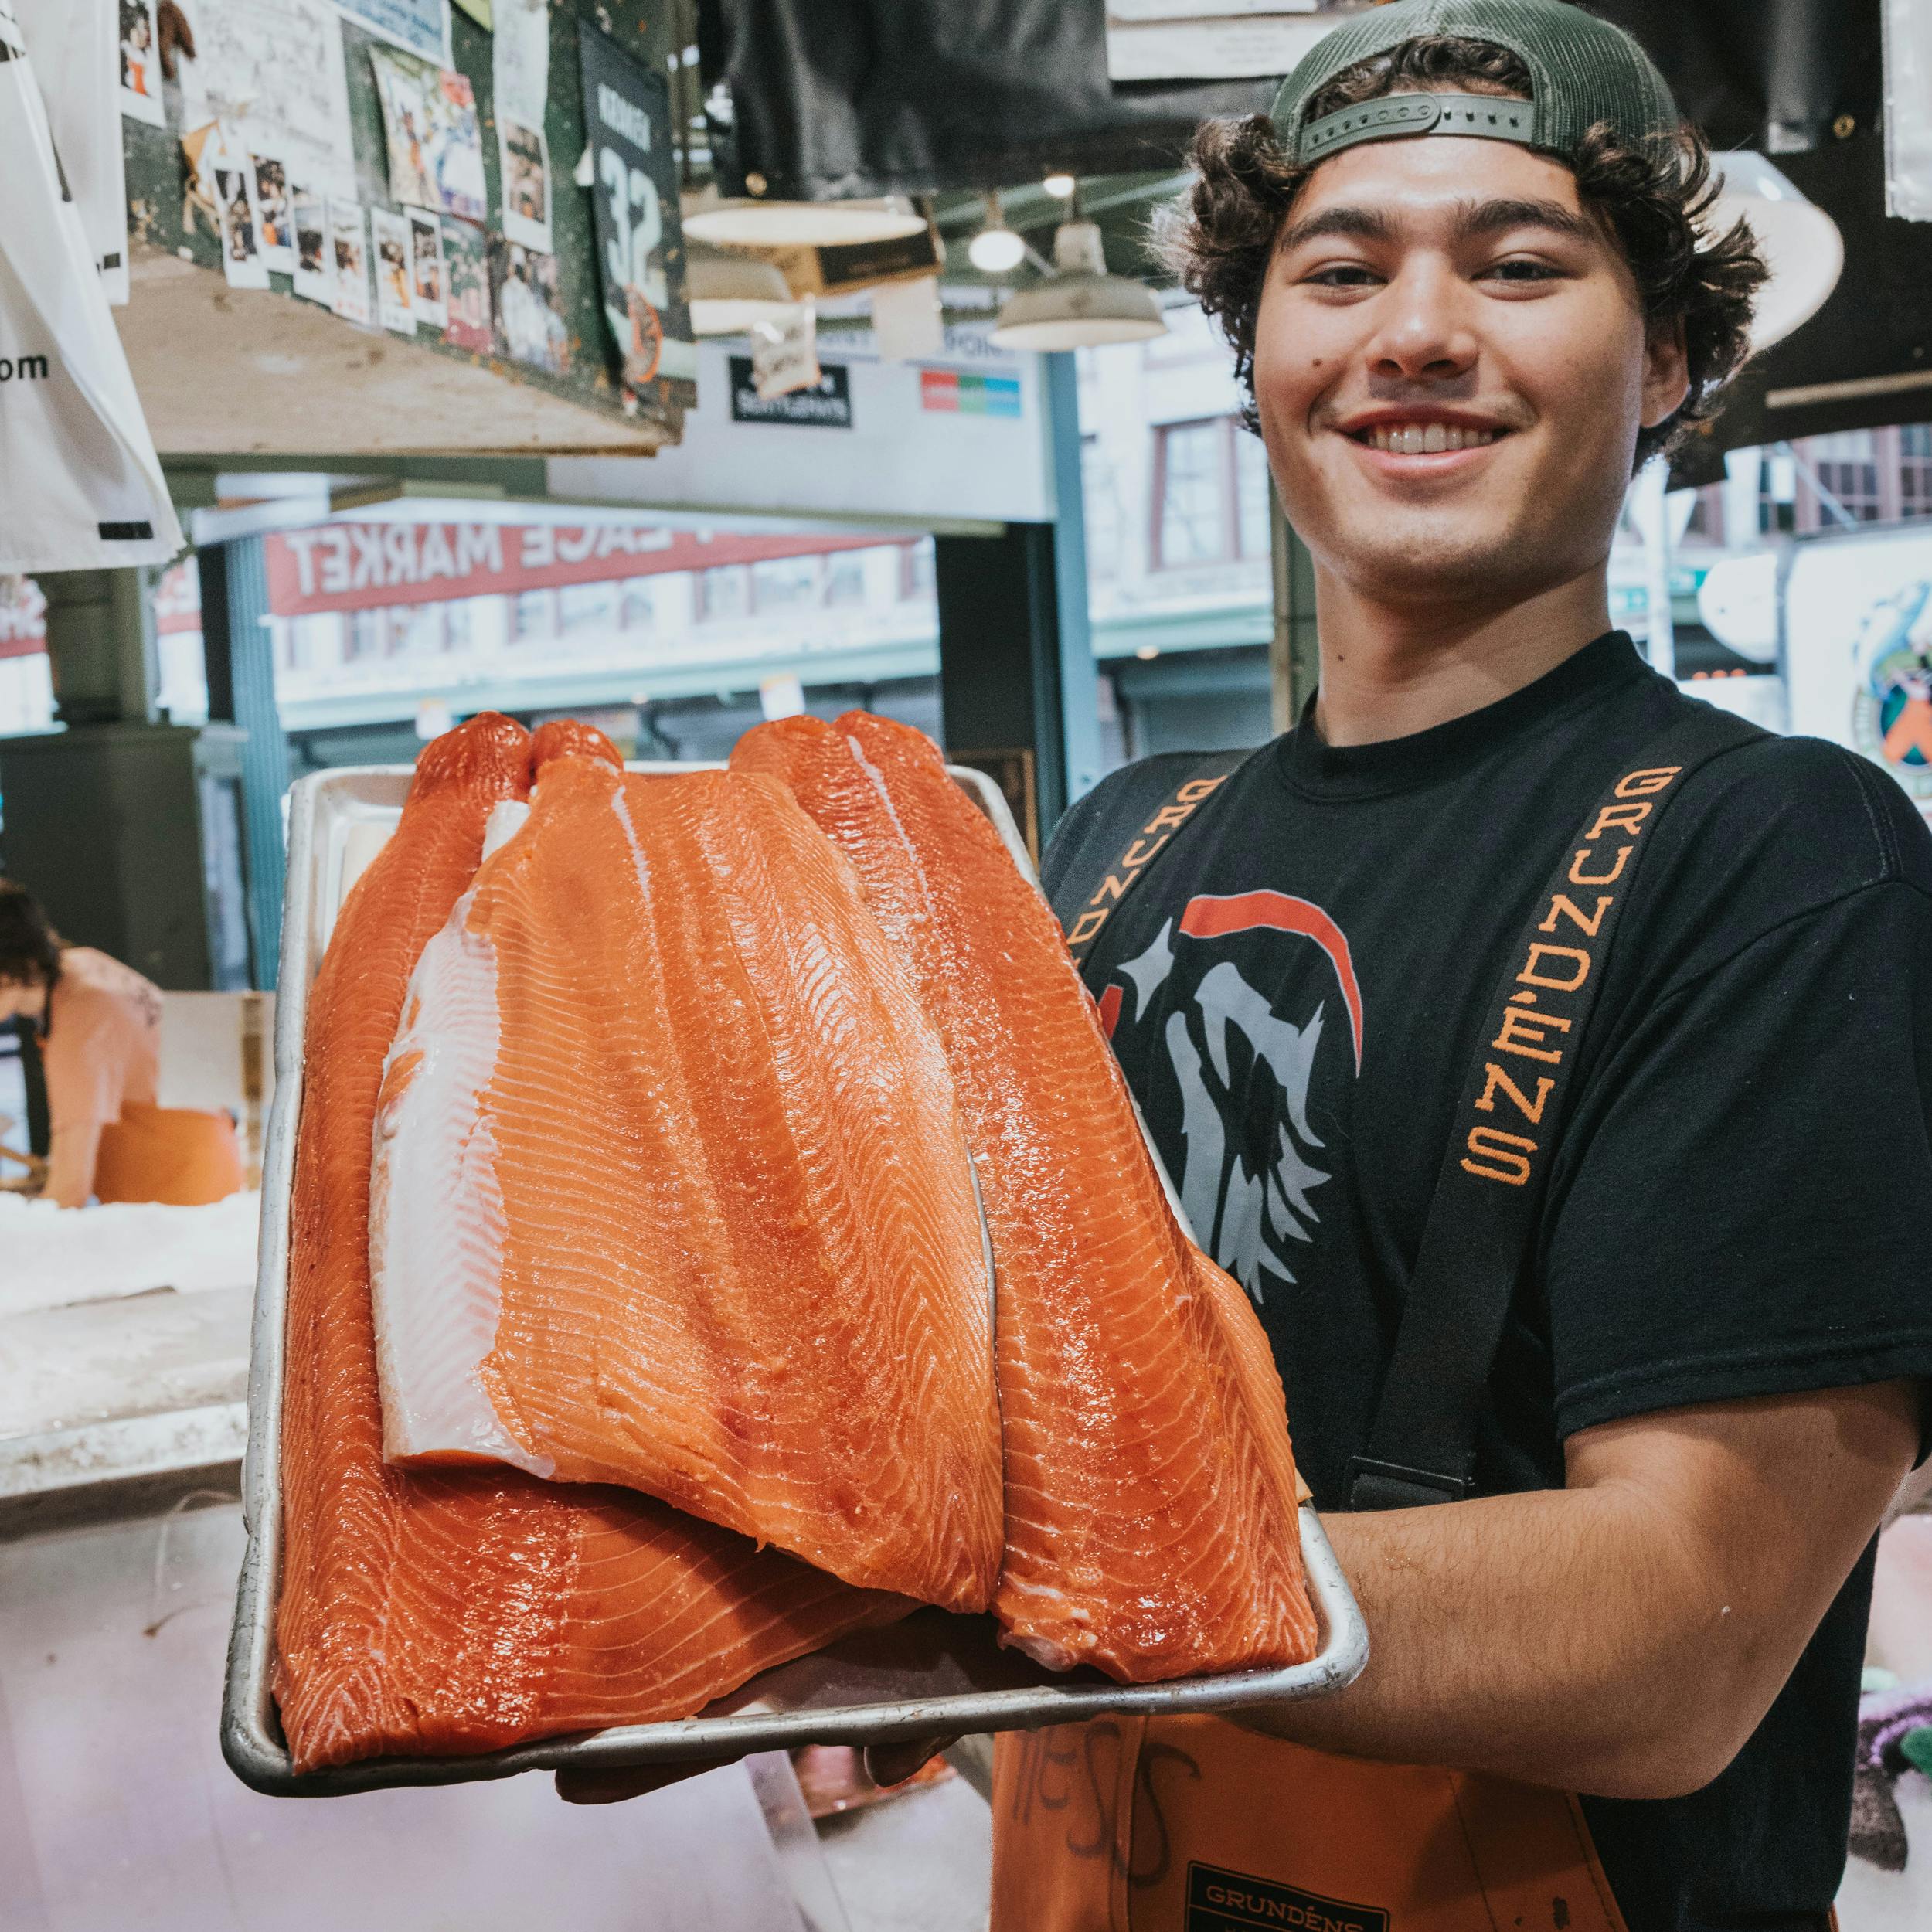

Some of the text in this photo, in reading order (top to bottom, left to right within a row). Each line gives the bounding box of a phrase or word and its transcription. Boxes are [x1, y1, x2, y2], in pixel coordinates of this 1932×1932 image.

[600, 146, 668, 310] 32
[1067, 774, 1228, 966] GRUND
[1460, 766, 1682, 1186] GRUNDÉNS
